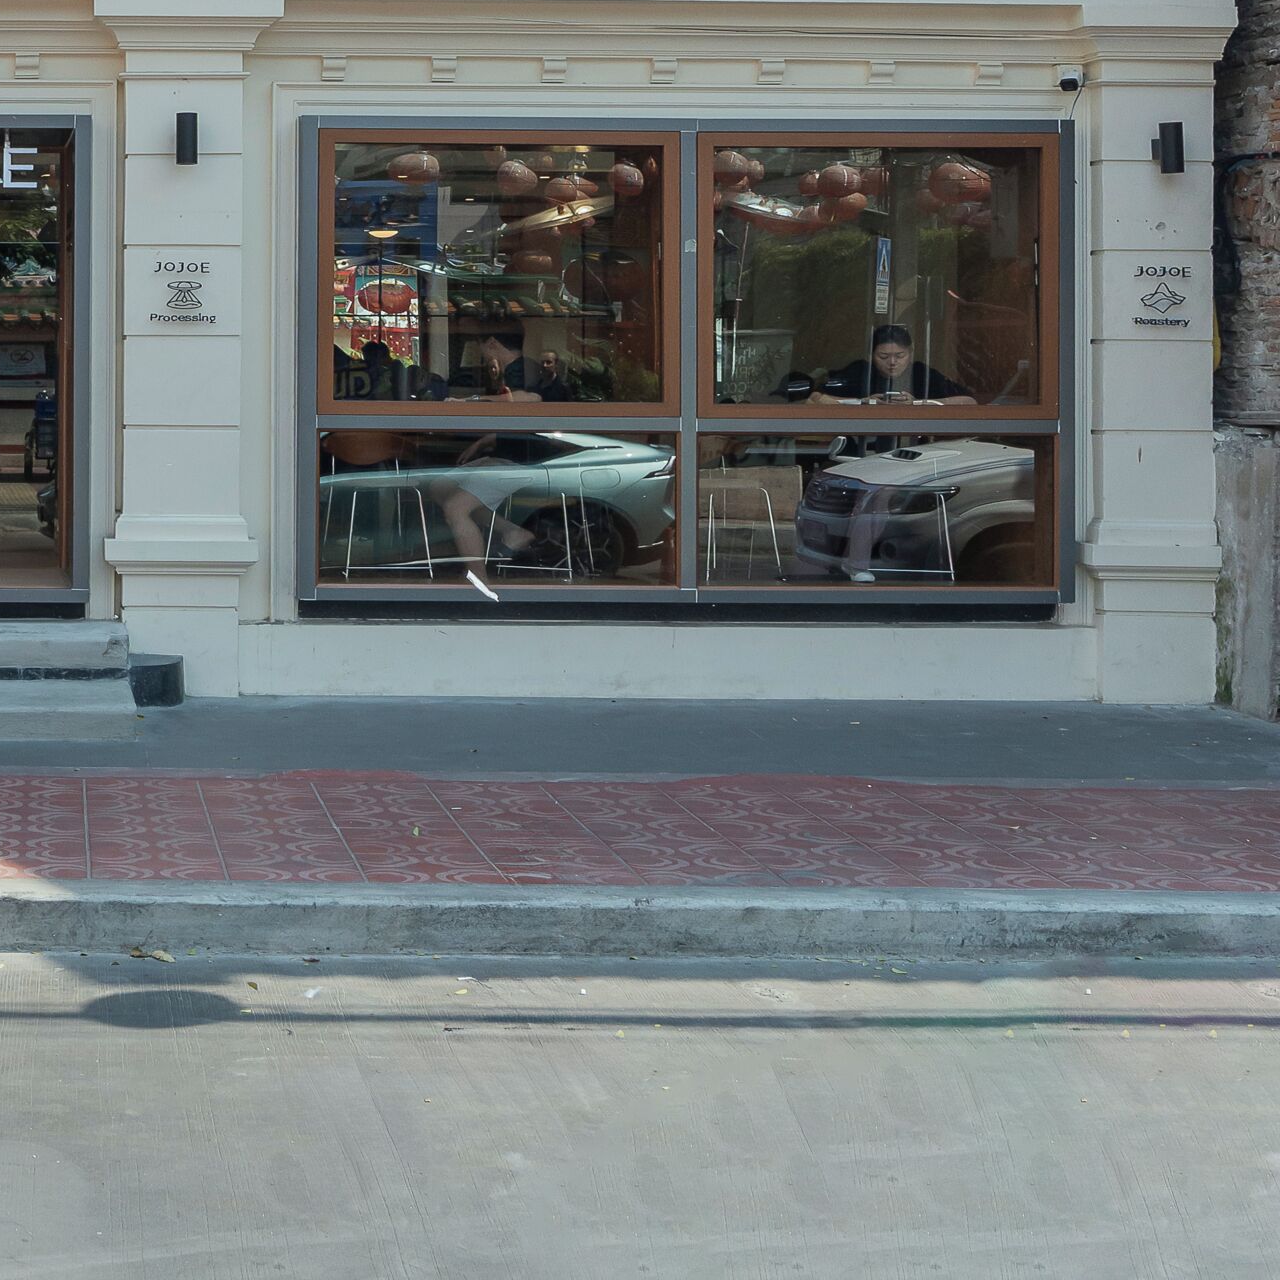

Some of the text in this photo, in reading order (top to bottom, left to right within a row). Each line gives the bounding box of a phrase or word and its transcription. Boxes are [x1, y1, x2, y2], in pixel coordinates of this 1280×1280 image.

[153, 261, 210, 274] JOJOE
[1133, 266, 1192, 278] JOJOE
[149, 313, 217, 324] Processing
[1133, 316, 1191, 328] Roastery
